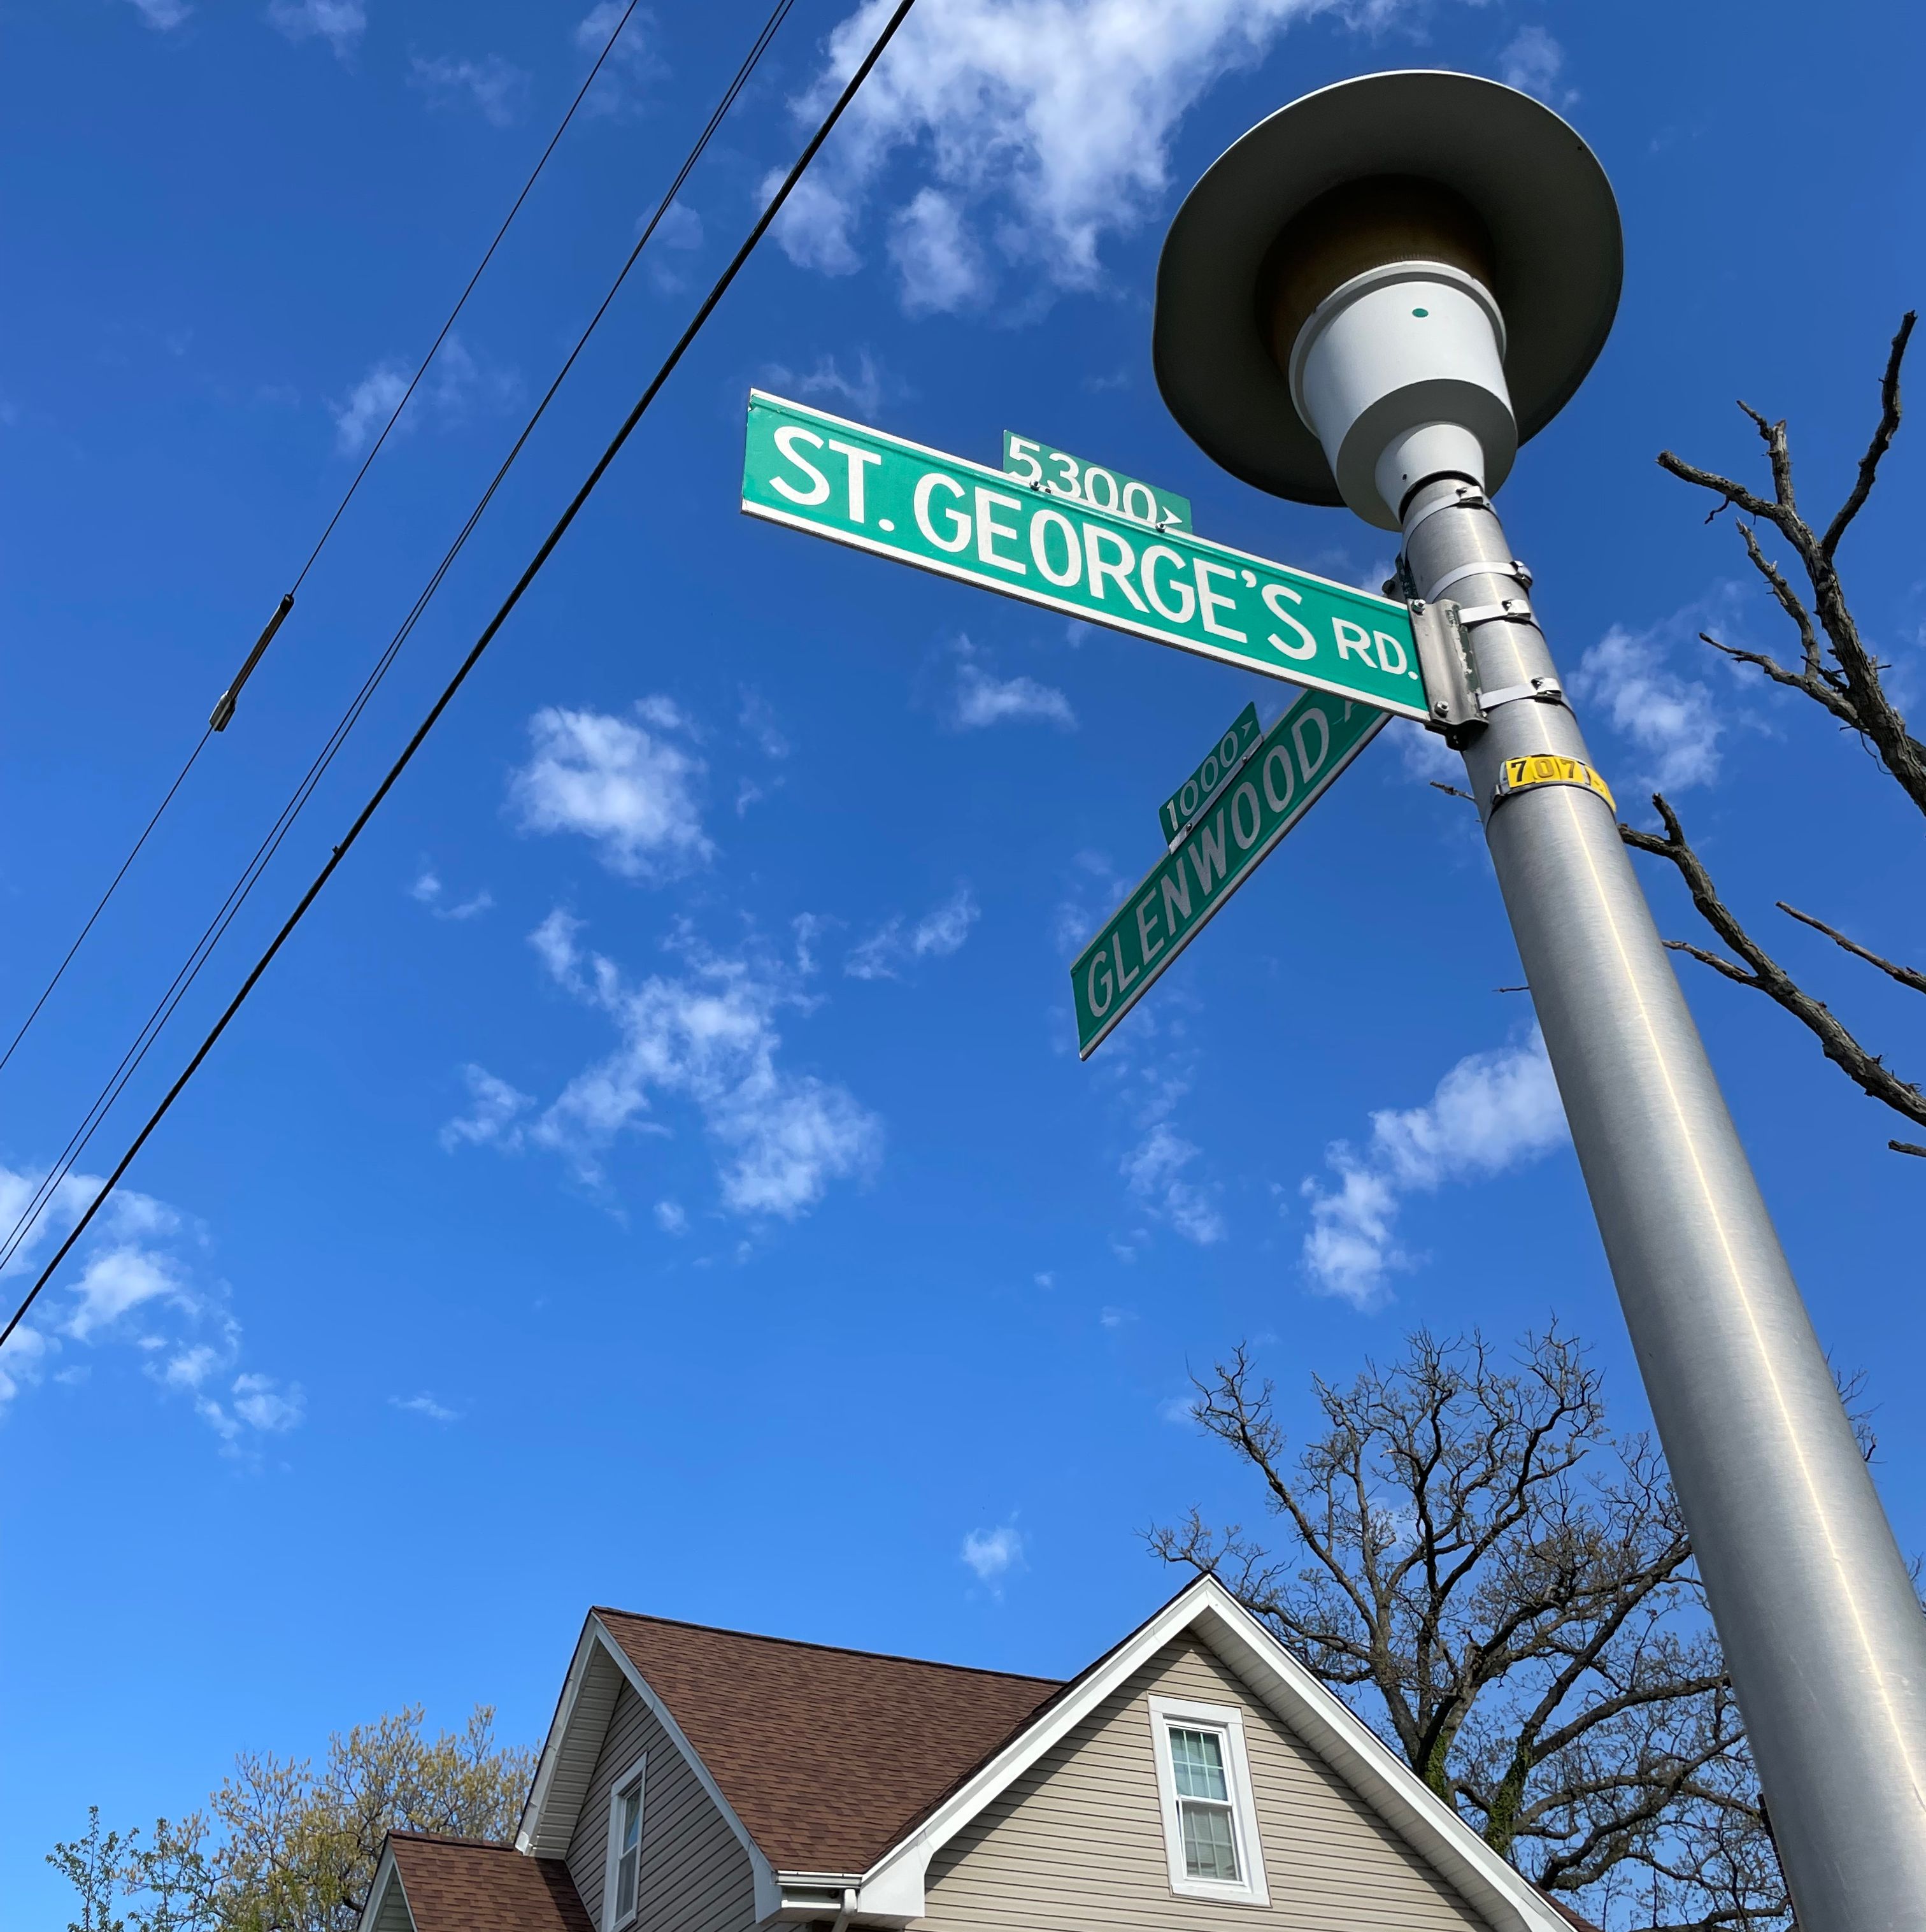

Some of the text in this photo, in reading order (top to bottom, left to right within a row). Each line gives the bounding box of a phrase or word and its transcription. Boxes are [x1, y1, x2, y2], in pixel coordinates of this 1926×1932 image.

[769, 426, 1418, 680] ST. GEORGE'S RD.
[1009, 436, 1157, 524] 5300
[1087, 708, 1329, 1017] GLENWOOD
[1167, 731, 1238, 831] 1000
